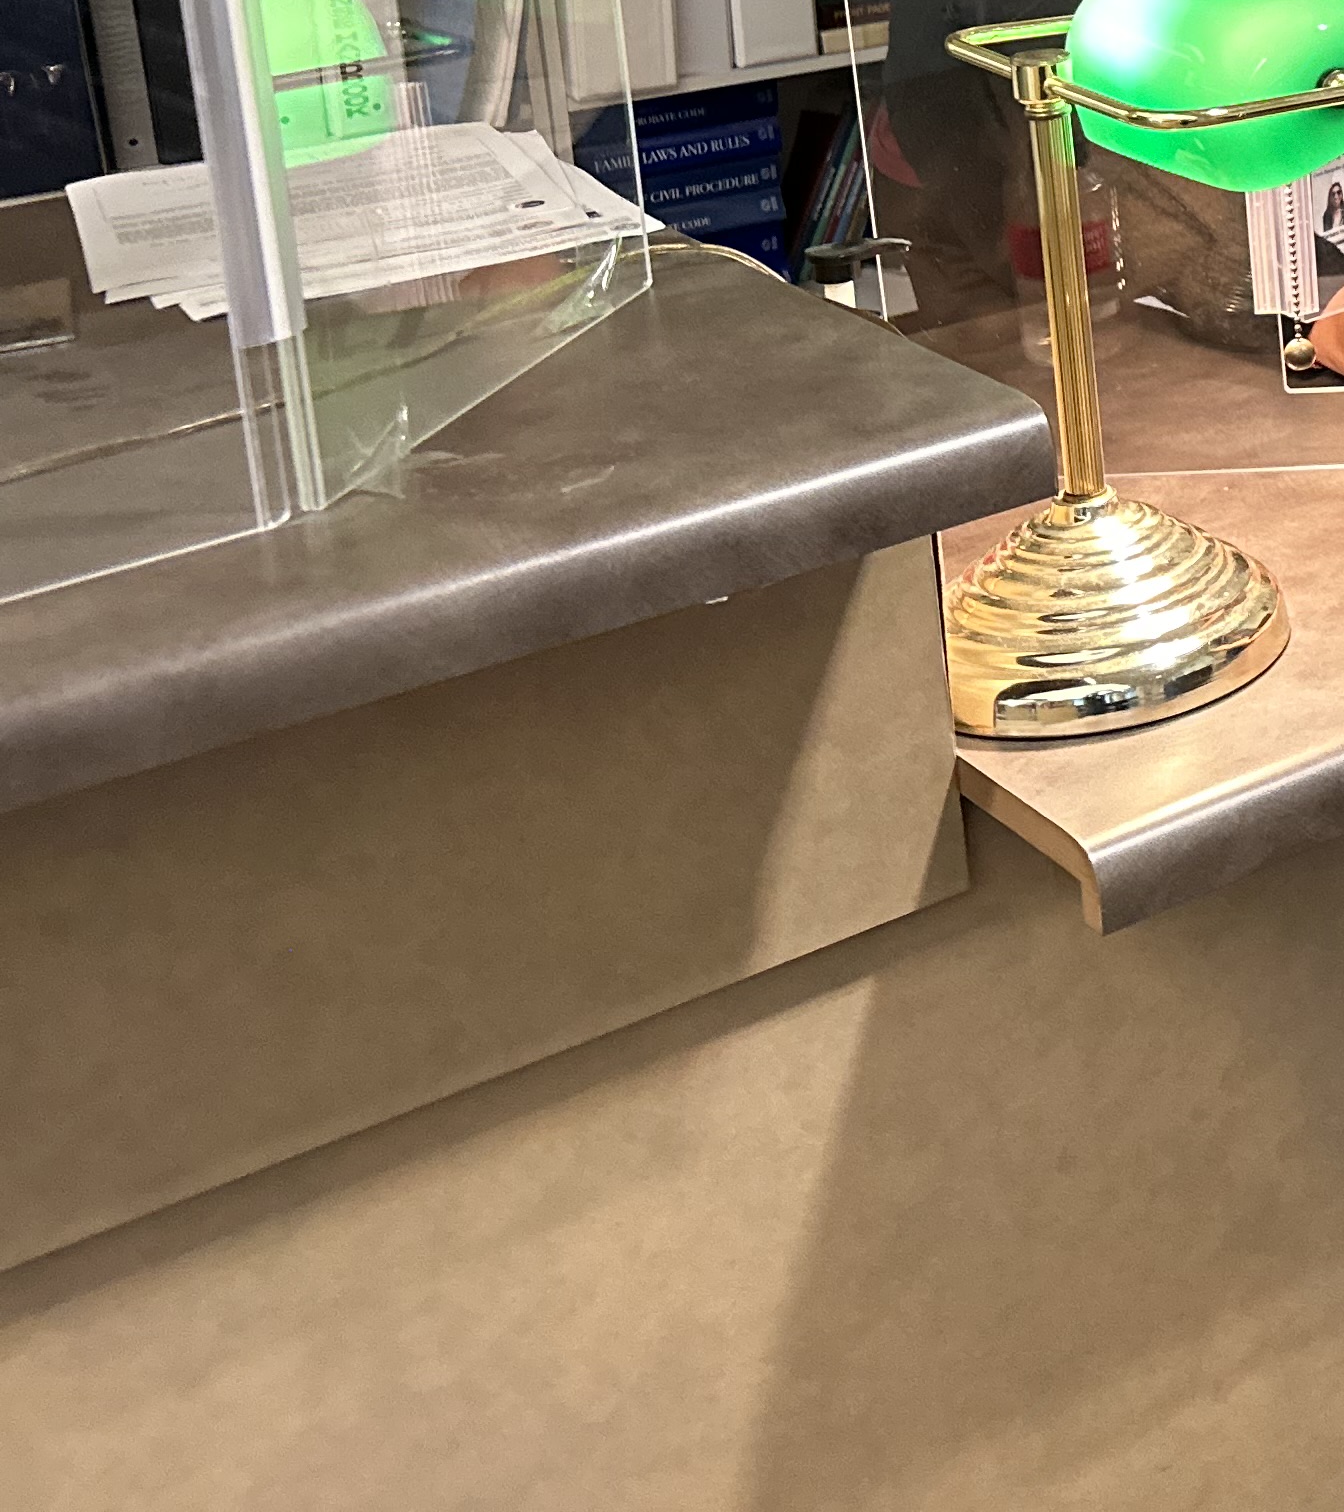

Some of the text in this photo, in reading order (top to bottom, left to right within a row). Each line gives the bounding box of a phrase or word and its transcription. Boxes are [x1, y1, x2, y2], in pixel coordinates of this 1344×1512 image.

[636, 111, 677, 126] ROBATE
[594, 134, 751, 174] FAMIL LAWS AND RULES
[650, 173, 760, 203] CIVIL PROCEDURE
